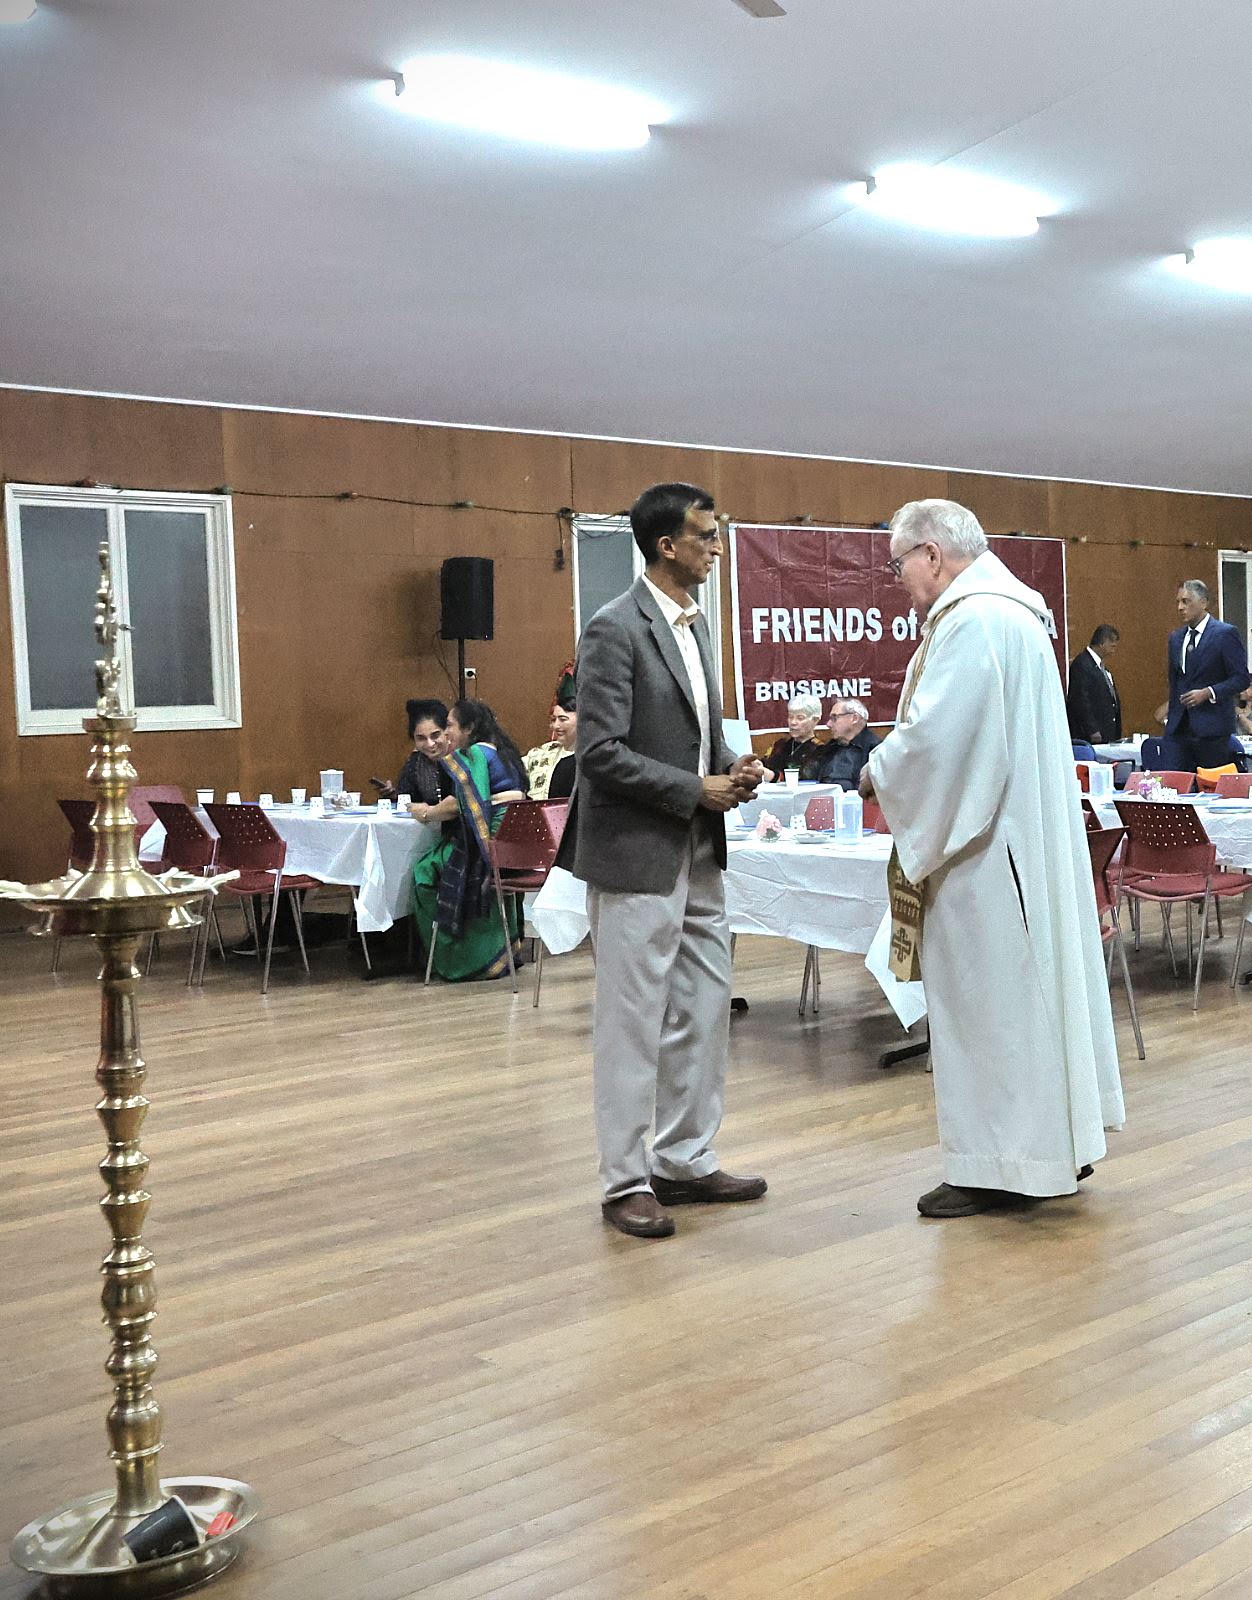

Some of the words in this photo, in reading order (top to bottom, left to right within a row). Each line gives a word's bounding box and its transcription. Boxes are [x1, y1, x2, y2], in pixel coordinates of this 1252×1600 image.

[751, 607, 883, 643] FRIENDS
[891, 607, 918, 641] of
[755, 678, 872, 702] BRISBANE
